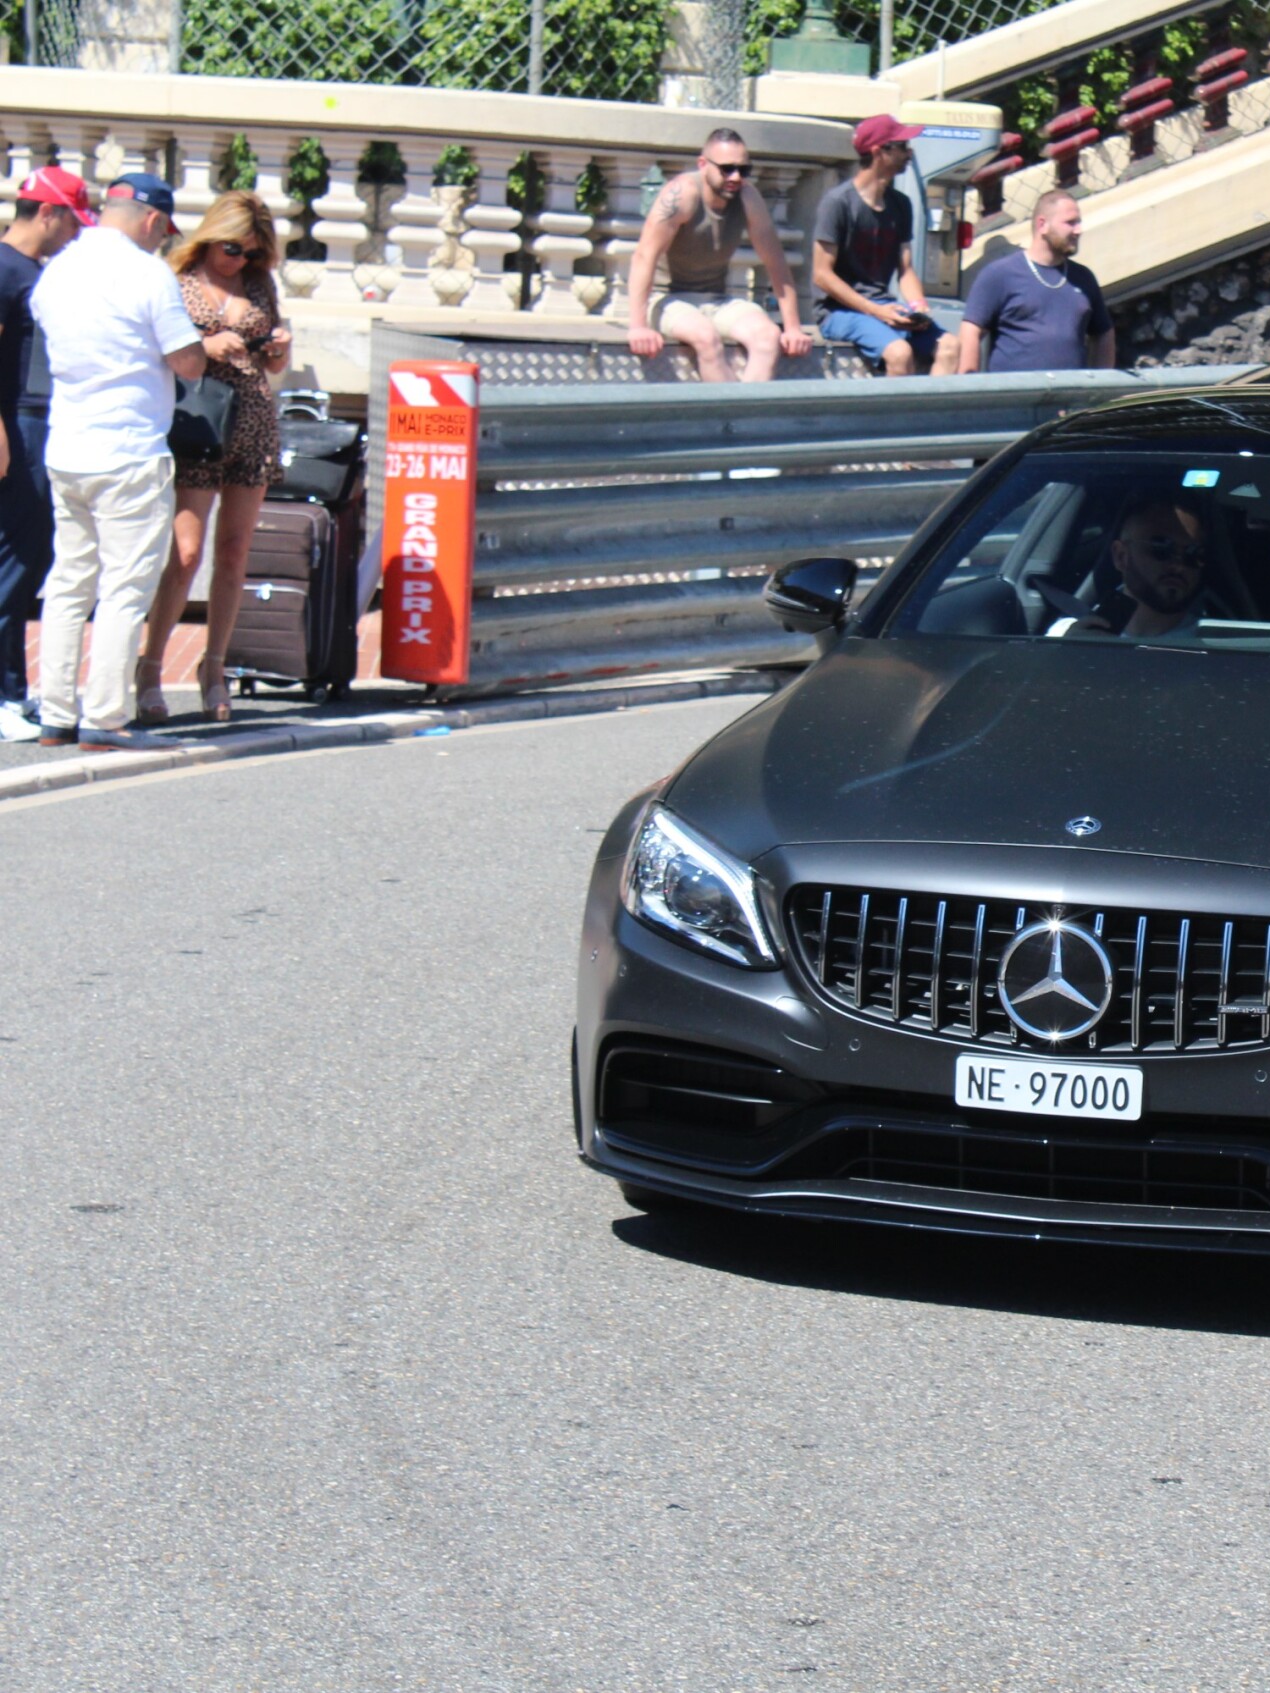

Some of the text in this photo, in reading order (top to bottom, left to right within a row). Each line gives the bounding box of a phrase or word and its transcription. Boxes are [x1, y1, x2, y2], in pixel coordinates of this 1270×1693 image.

[425, 413, 467, 424] MONACO
[425, 424, 466, 436] E-PRIX
[386, 454, 467, 480] 23-26 MAI
[402, 492, 438, 573] GRAND
[399, 580, 432, 645] PRIX
